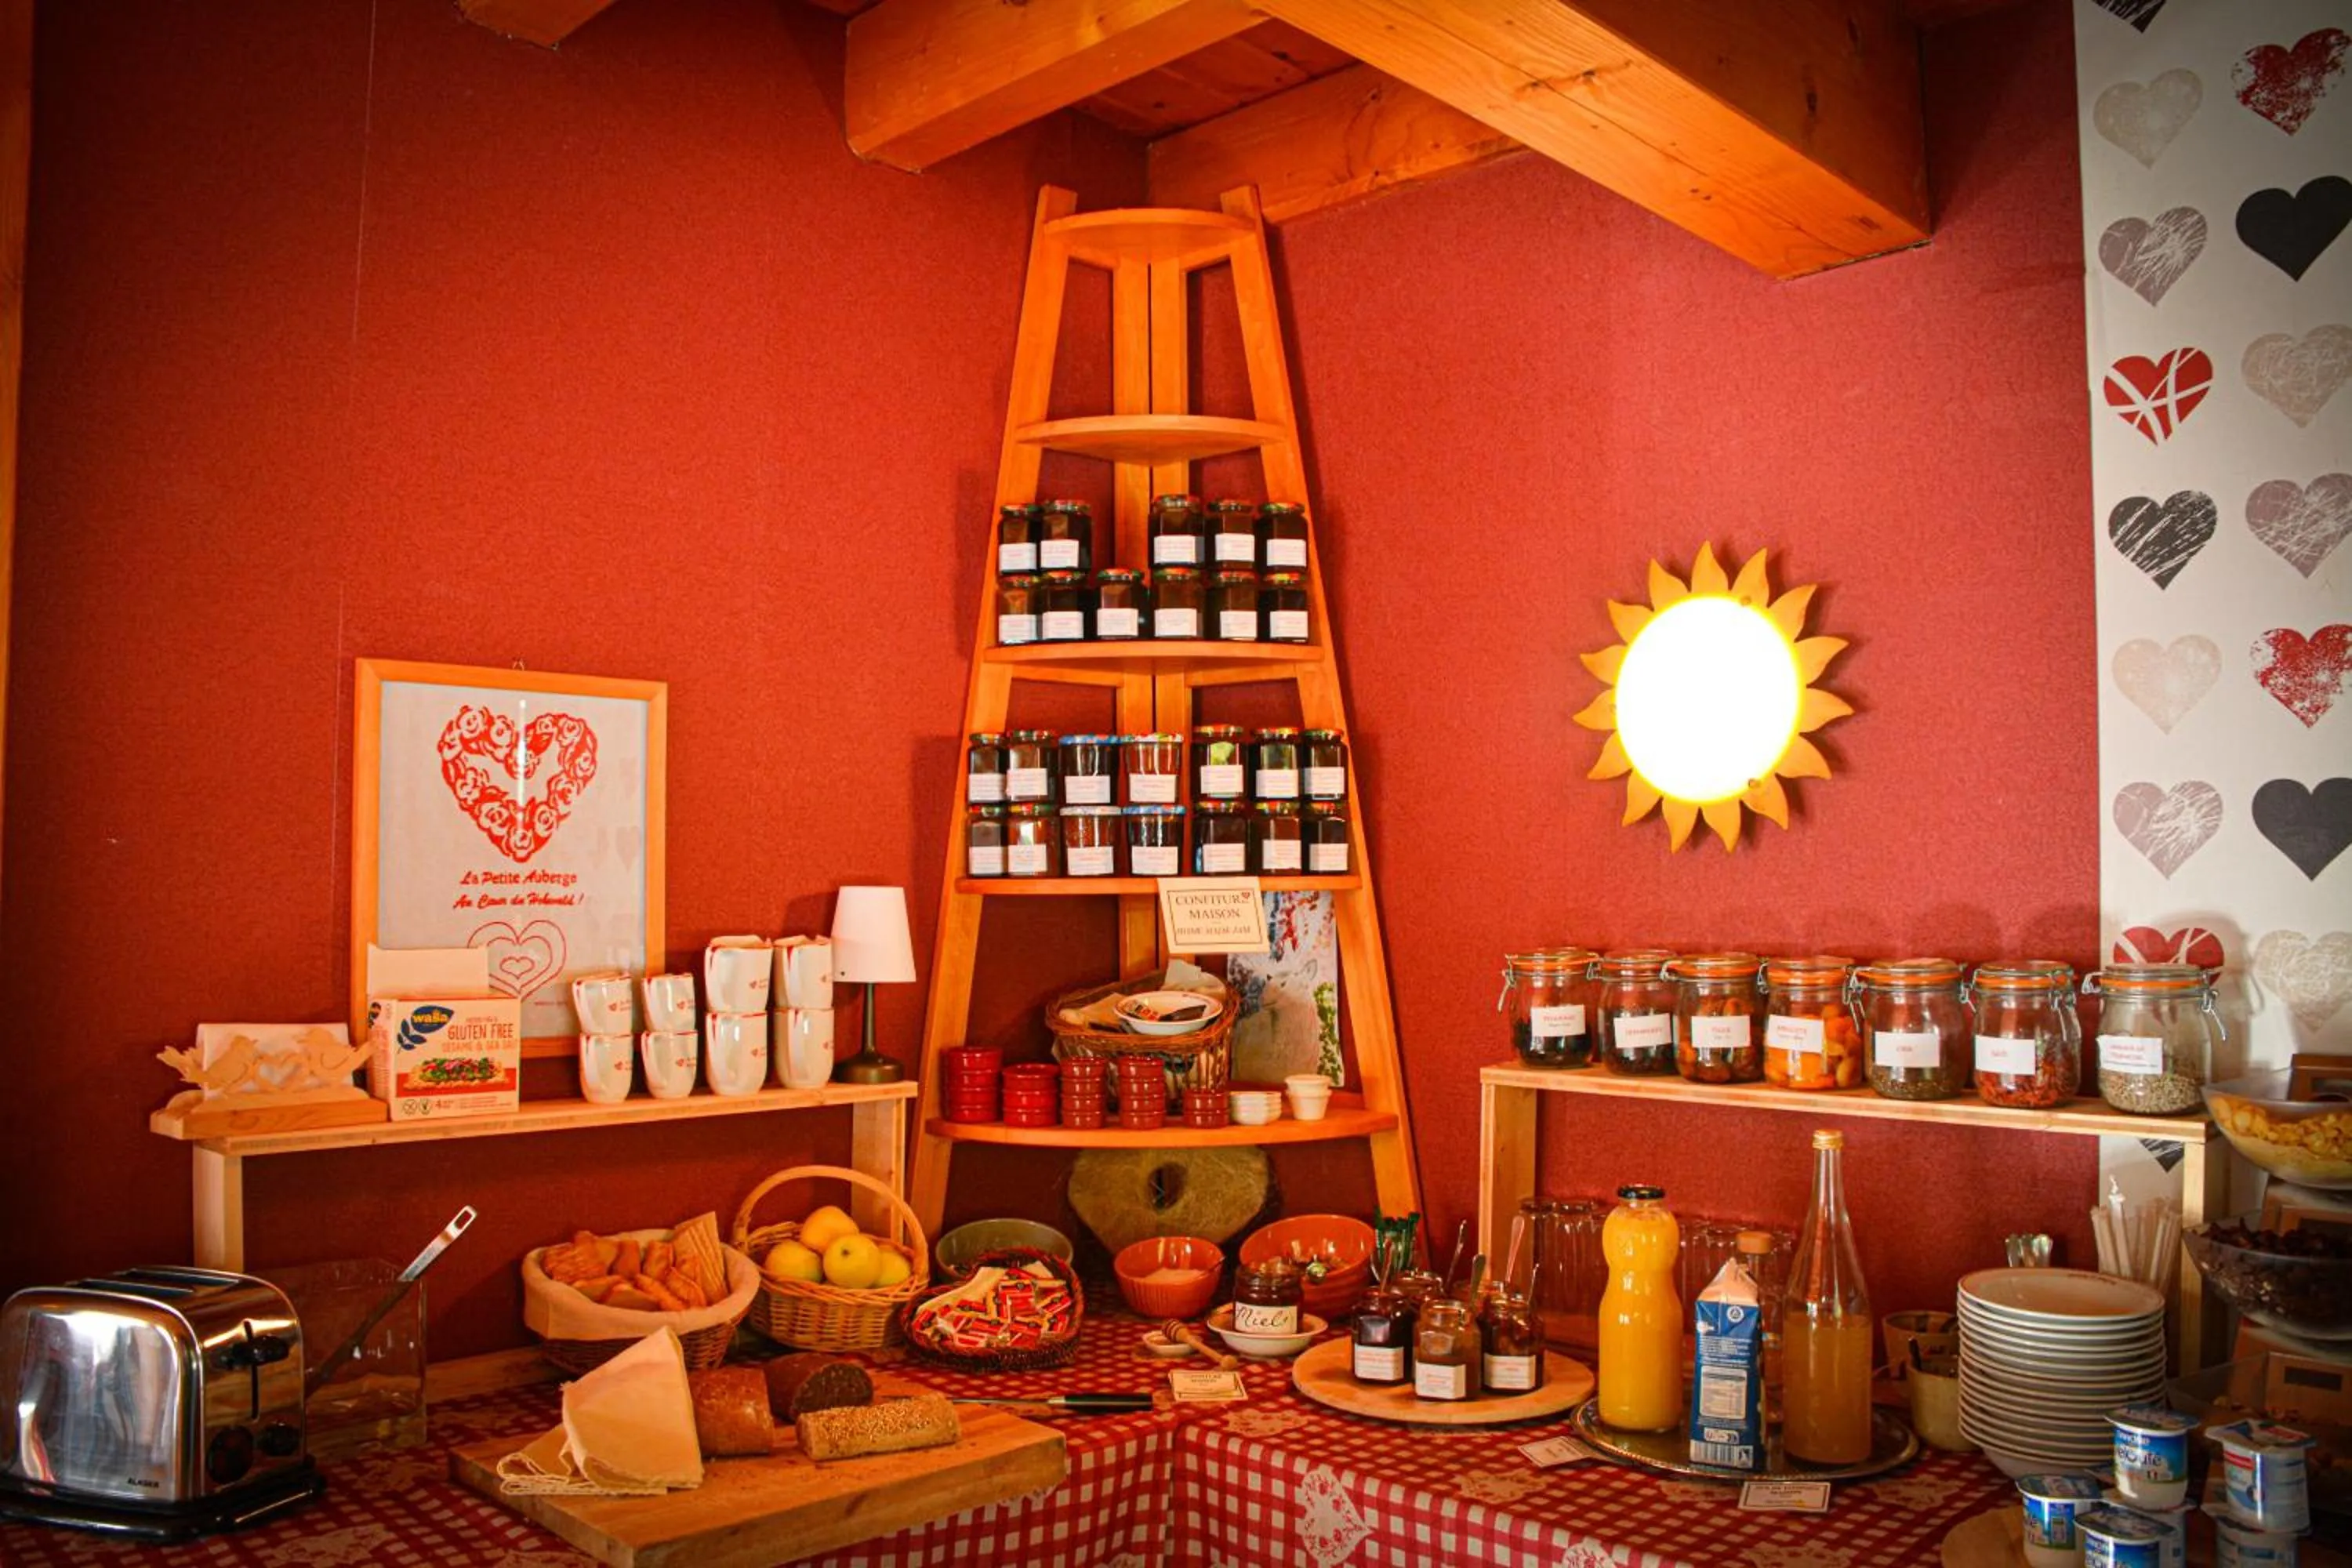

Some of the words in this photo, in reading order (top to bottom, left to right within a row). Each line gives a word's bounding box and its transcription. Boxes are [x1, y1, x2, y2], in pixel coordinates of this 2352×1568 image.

[459, 870, 478, 884] La
[482, 871, 521, 885] Petite
[523, 869, 577, 887] Auberge
[1189, 909, 1241, 920] MAISON
[448, 1024, 487, 1040] GLUTEN
[490, 1023, 514, 1039] FREE
